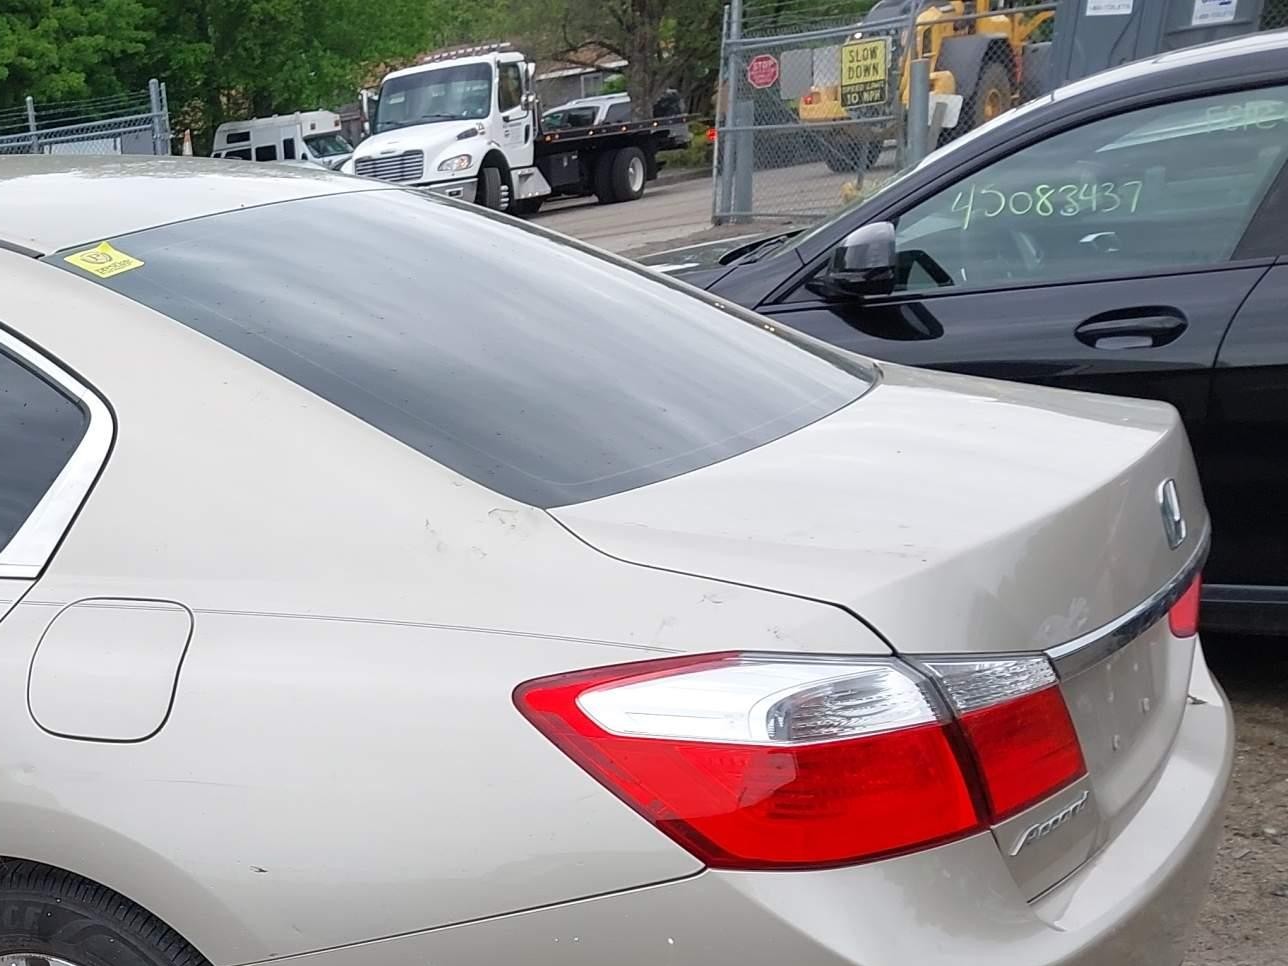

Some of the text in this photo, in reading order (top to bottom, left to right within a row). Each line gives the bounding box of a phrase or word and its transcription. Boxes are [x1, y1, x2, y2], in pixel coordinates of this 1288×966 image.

[848, 47, 879, 63] SLOW
[848, 62, 879, 80] DOWN
[847, 90, 882, 105] 10 MPH
[1009, 789, 1089, 857] Accord
